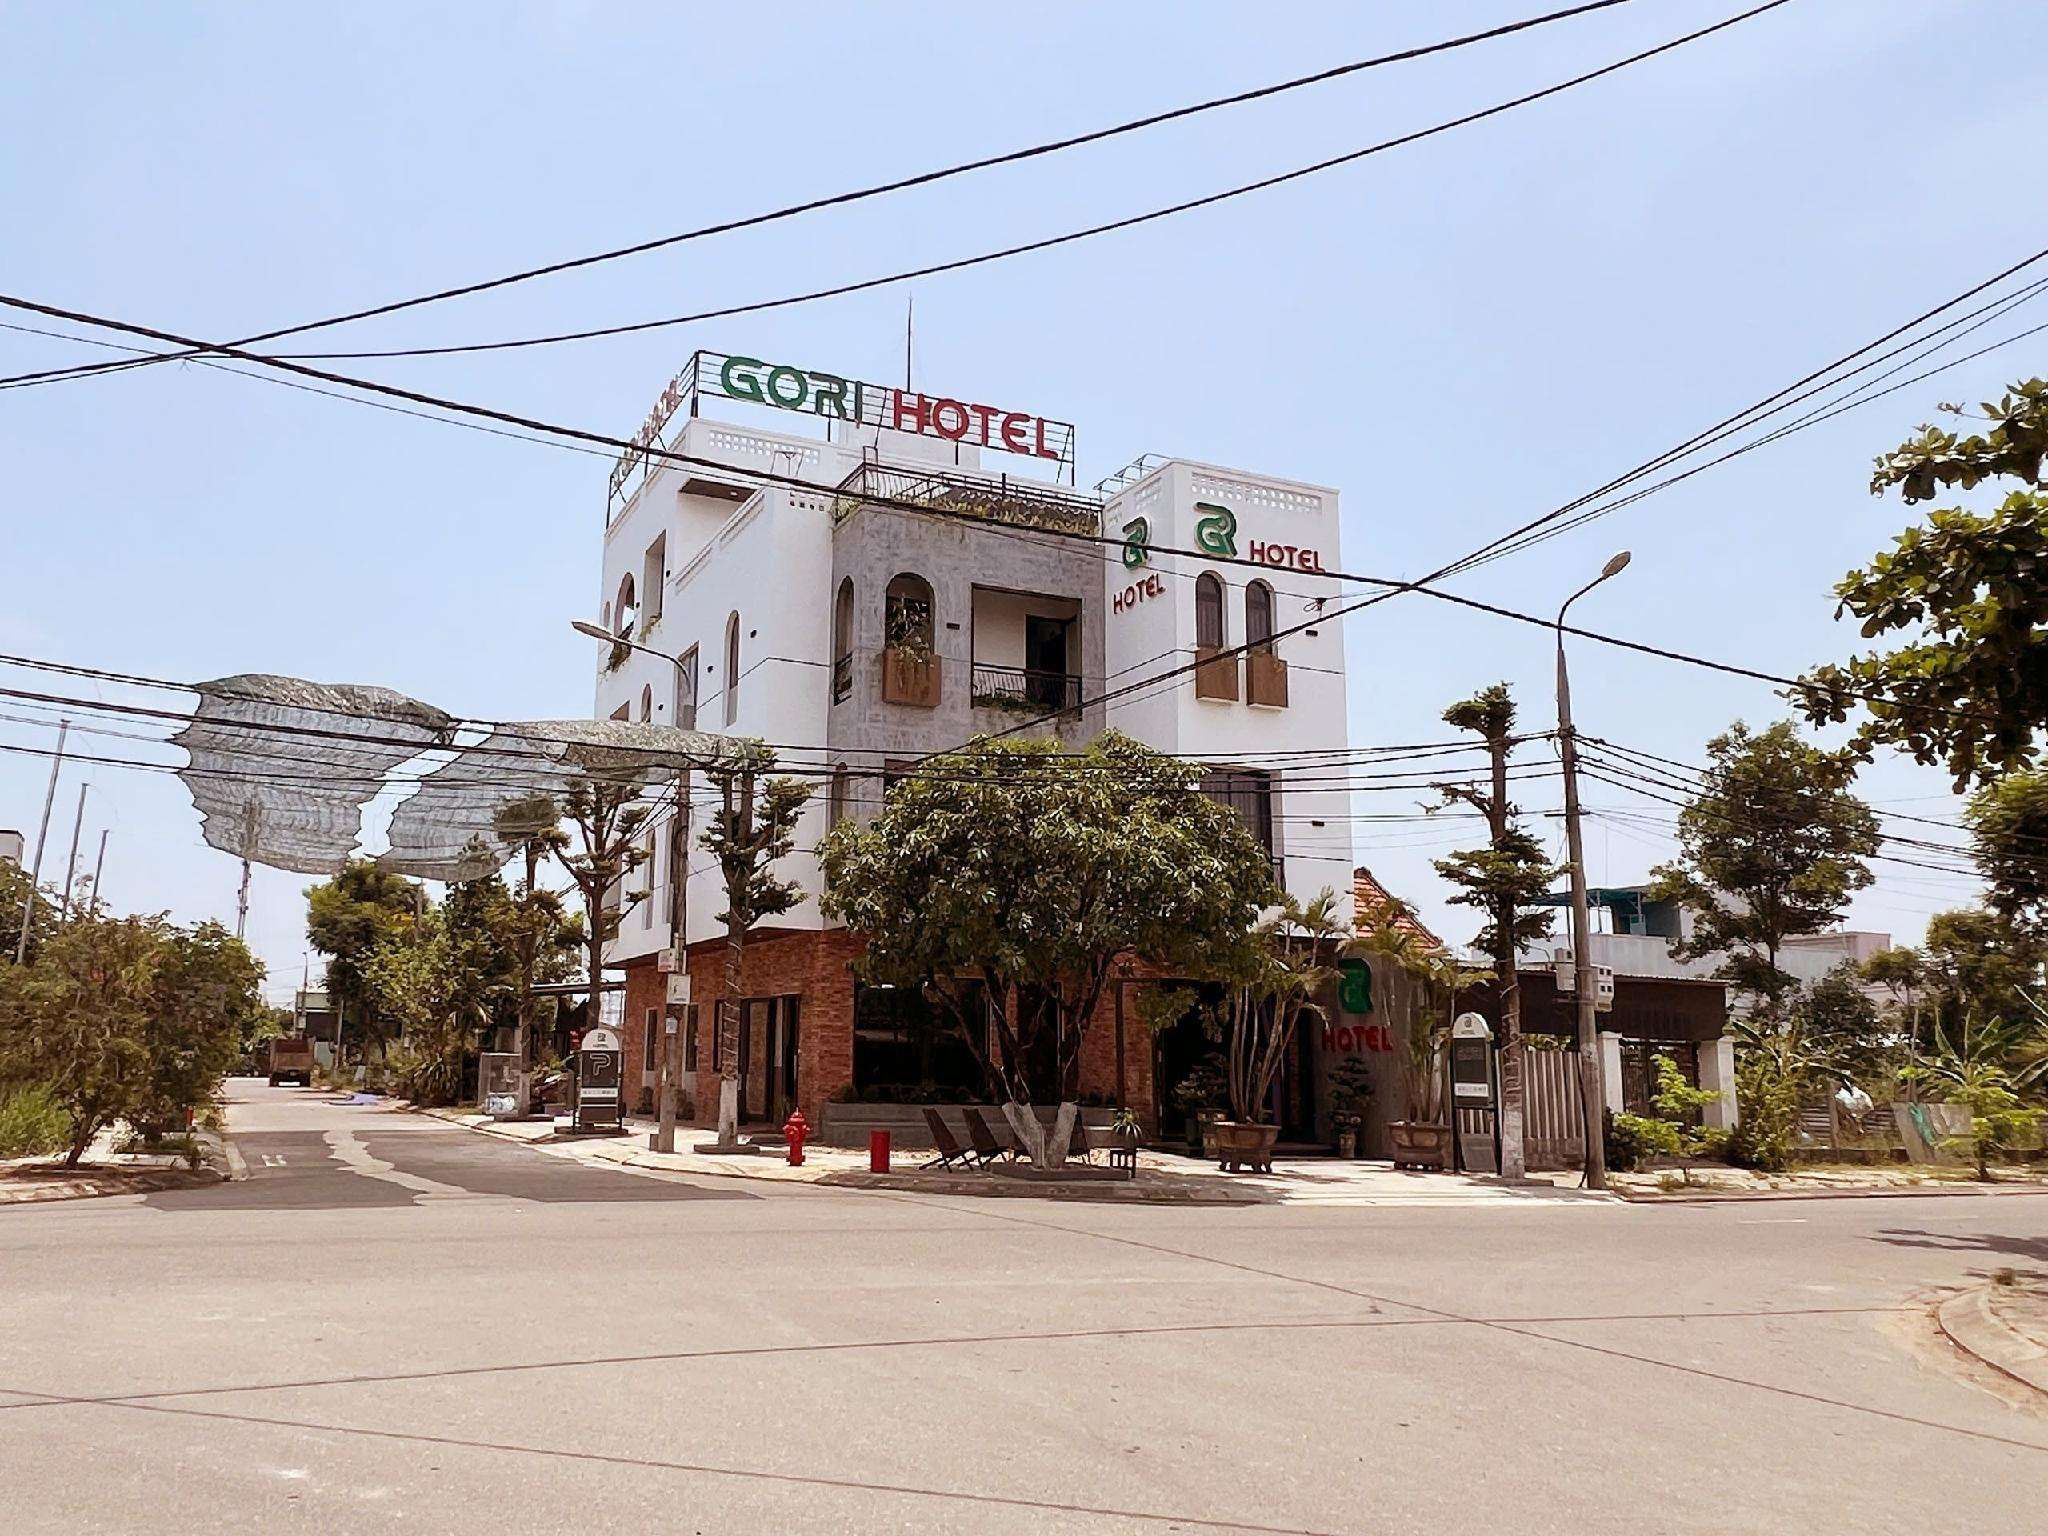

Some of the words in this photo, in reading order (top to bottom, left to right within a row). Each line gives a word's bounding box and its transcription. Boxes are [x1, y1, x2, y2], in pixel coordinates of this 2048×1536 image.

[721, 356, 863, 429] GORI
[893, 389, 1059, 459] HOTEL
[1250, 540, 1326, 573] HOTEL
[1113, 573, 1167, 615] HOTEL
[1321, 1025, 1394, 1053] HOTEL
[589, 1053, 611, 1076] P
